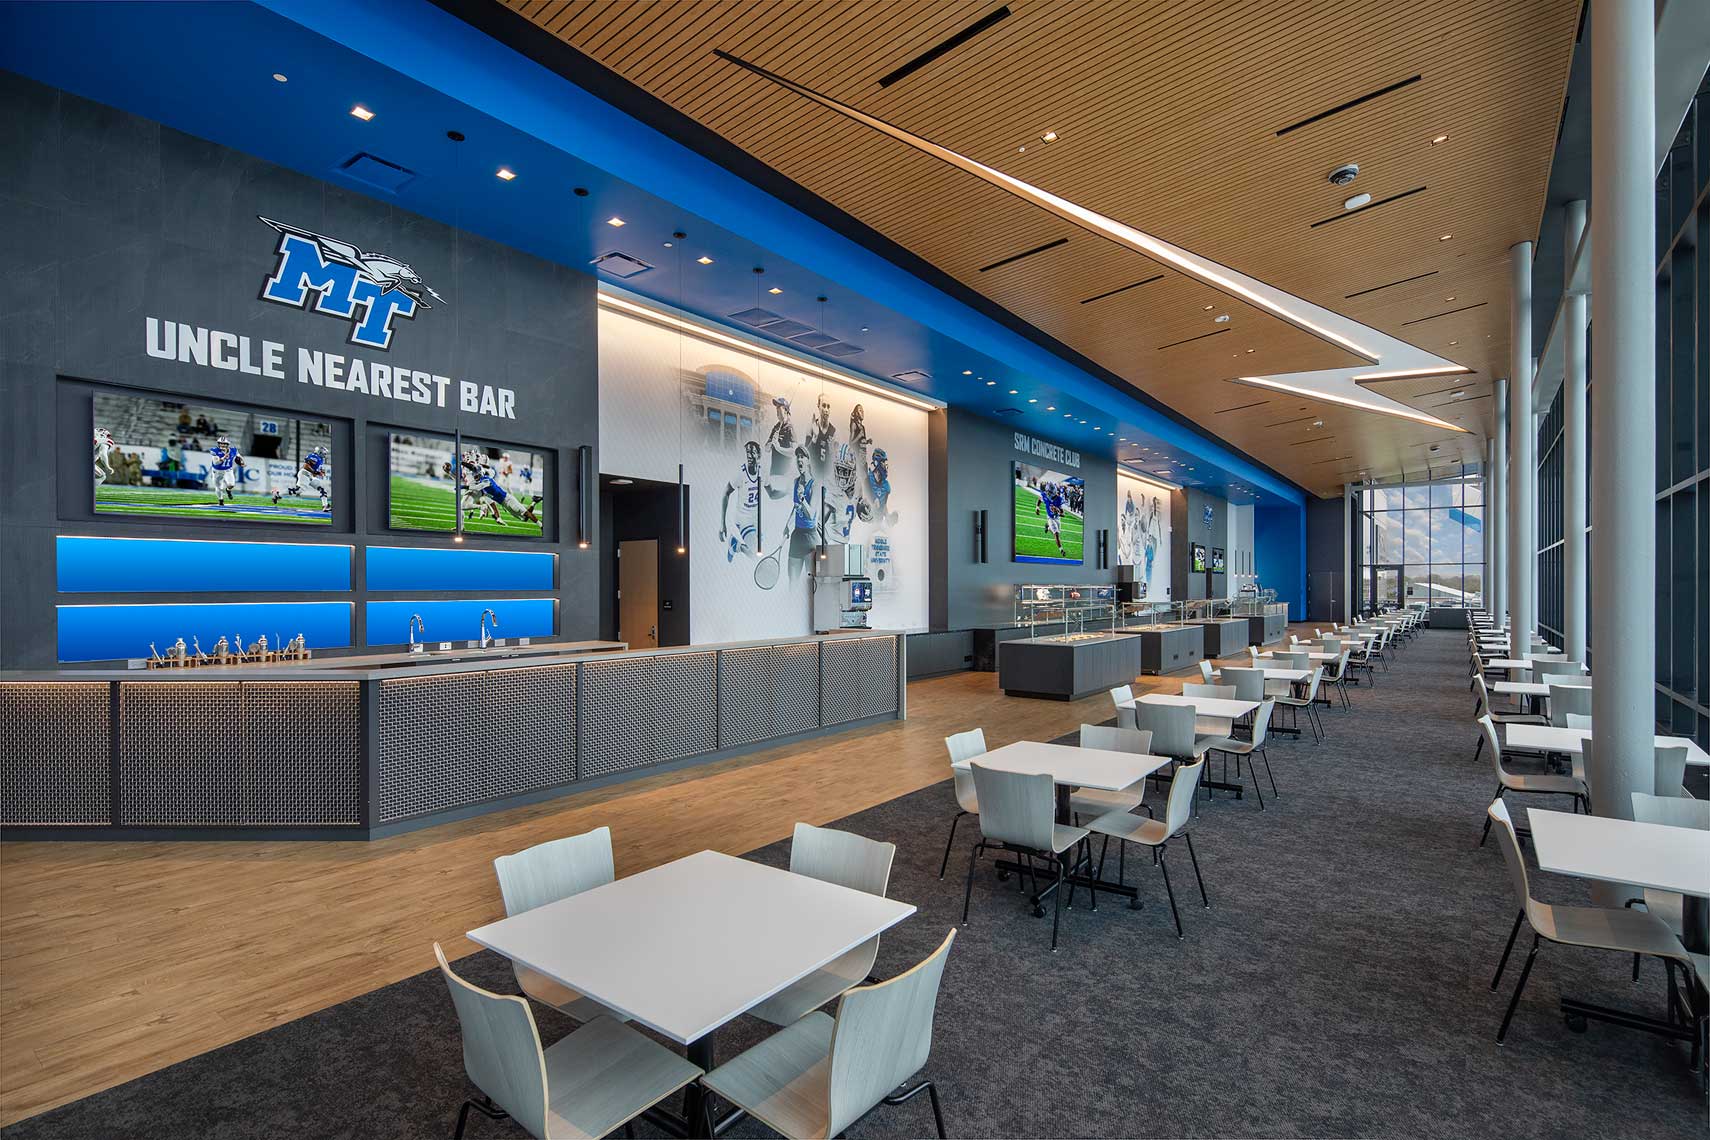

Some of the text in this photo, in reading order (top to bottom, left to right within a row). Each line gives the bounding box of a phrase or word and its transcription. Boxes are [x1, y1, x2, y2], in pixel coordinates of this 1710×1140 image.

[259, 231, 418, 350] MT
[146, 317, 516, 420] UNCLE NEAREST BAR
[1014, 432, 1080, 468] SRM CONCRETE CLUB
